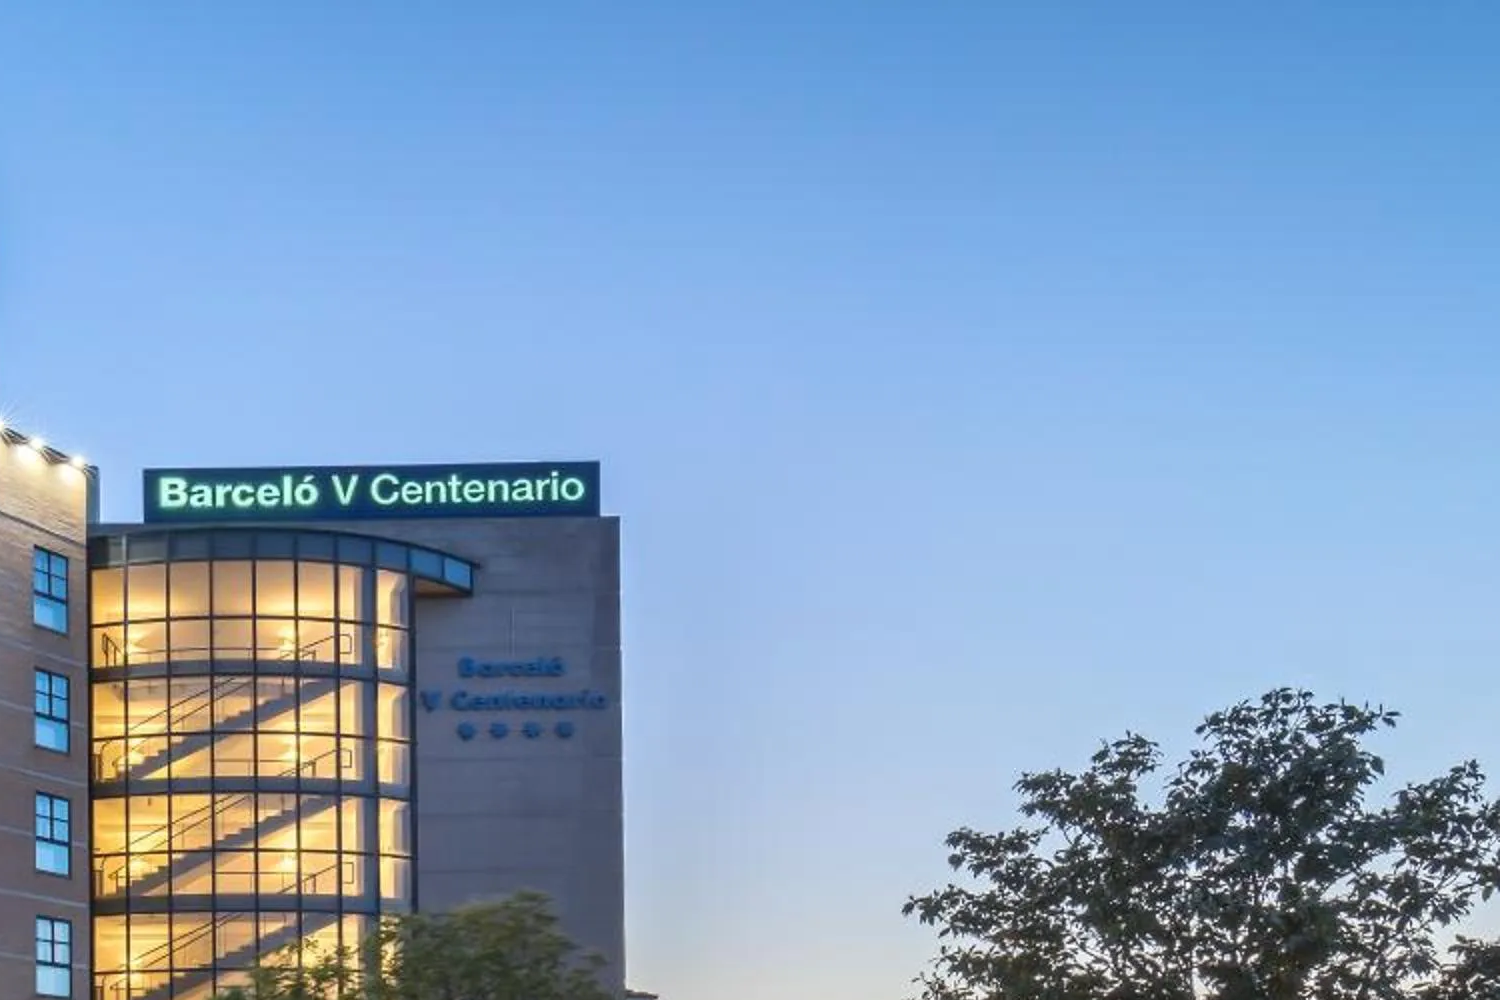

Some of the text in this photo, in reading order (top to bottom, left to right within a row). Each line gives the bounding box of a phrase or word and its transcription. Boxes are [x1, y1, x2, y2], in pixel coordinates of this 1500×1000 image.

[158, 470, 586, 508] Barceló V Centenario
